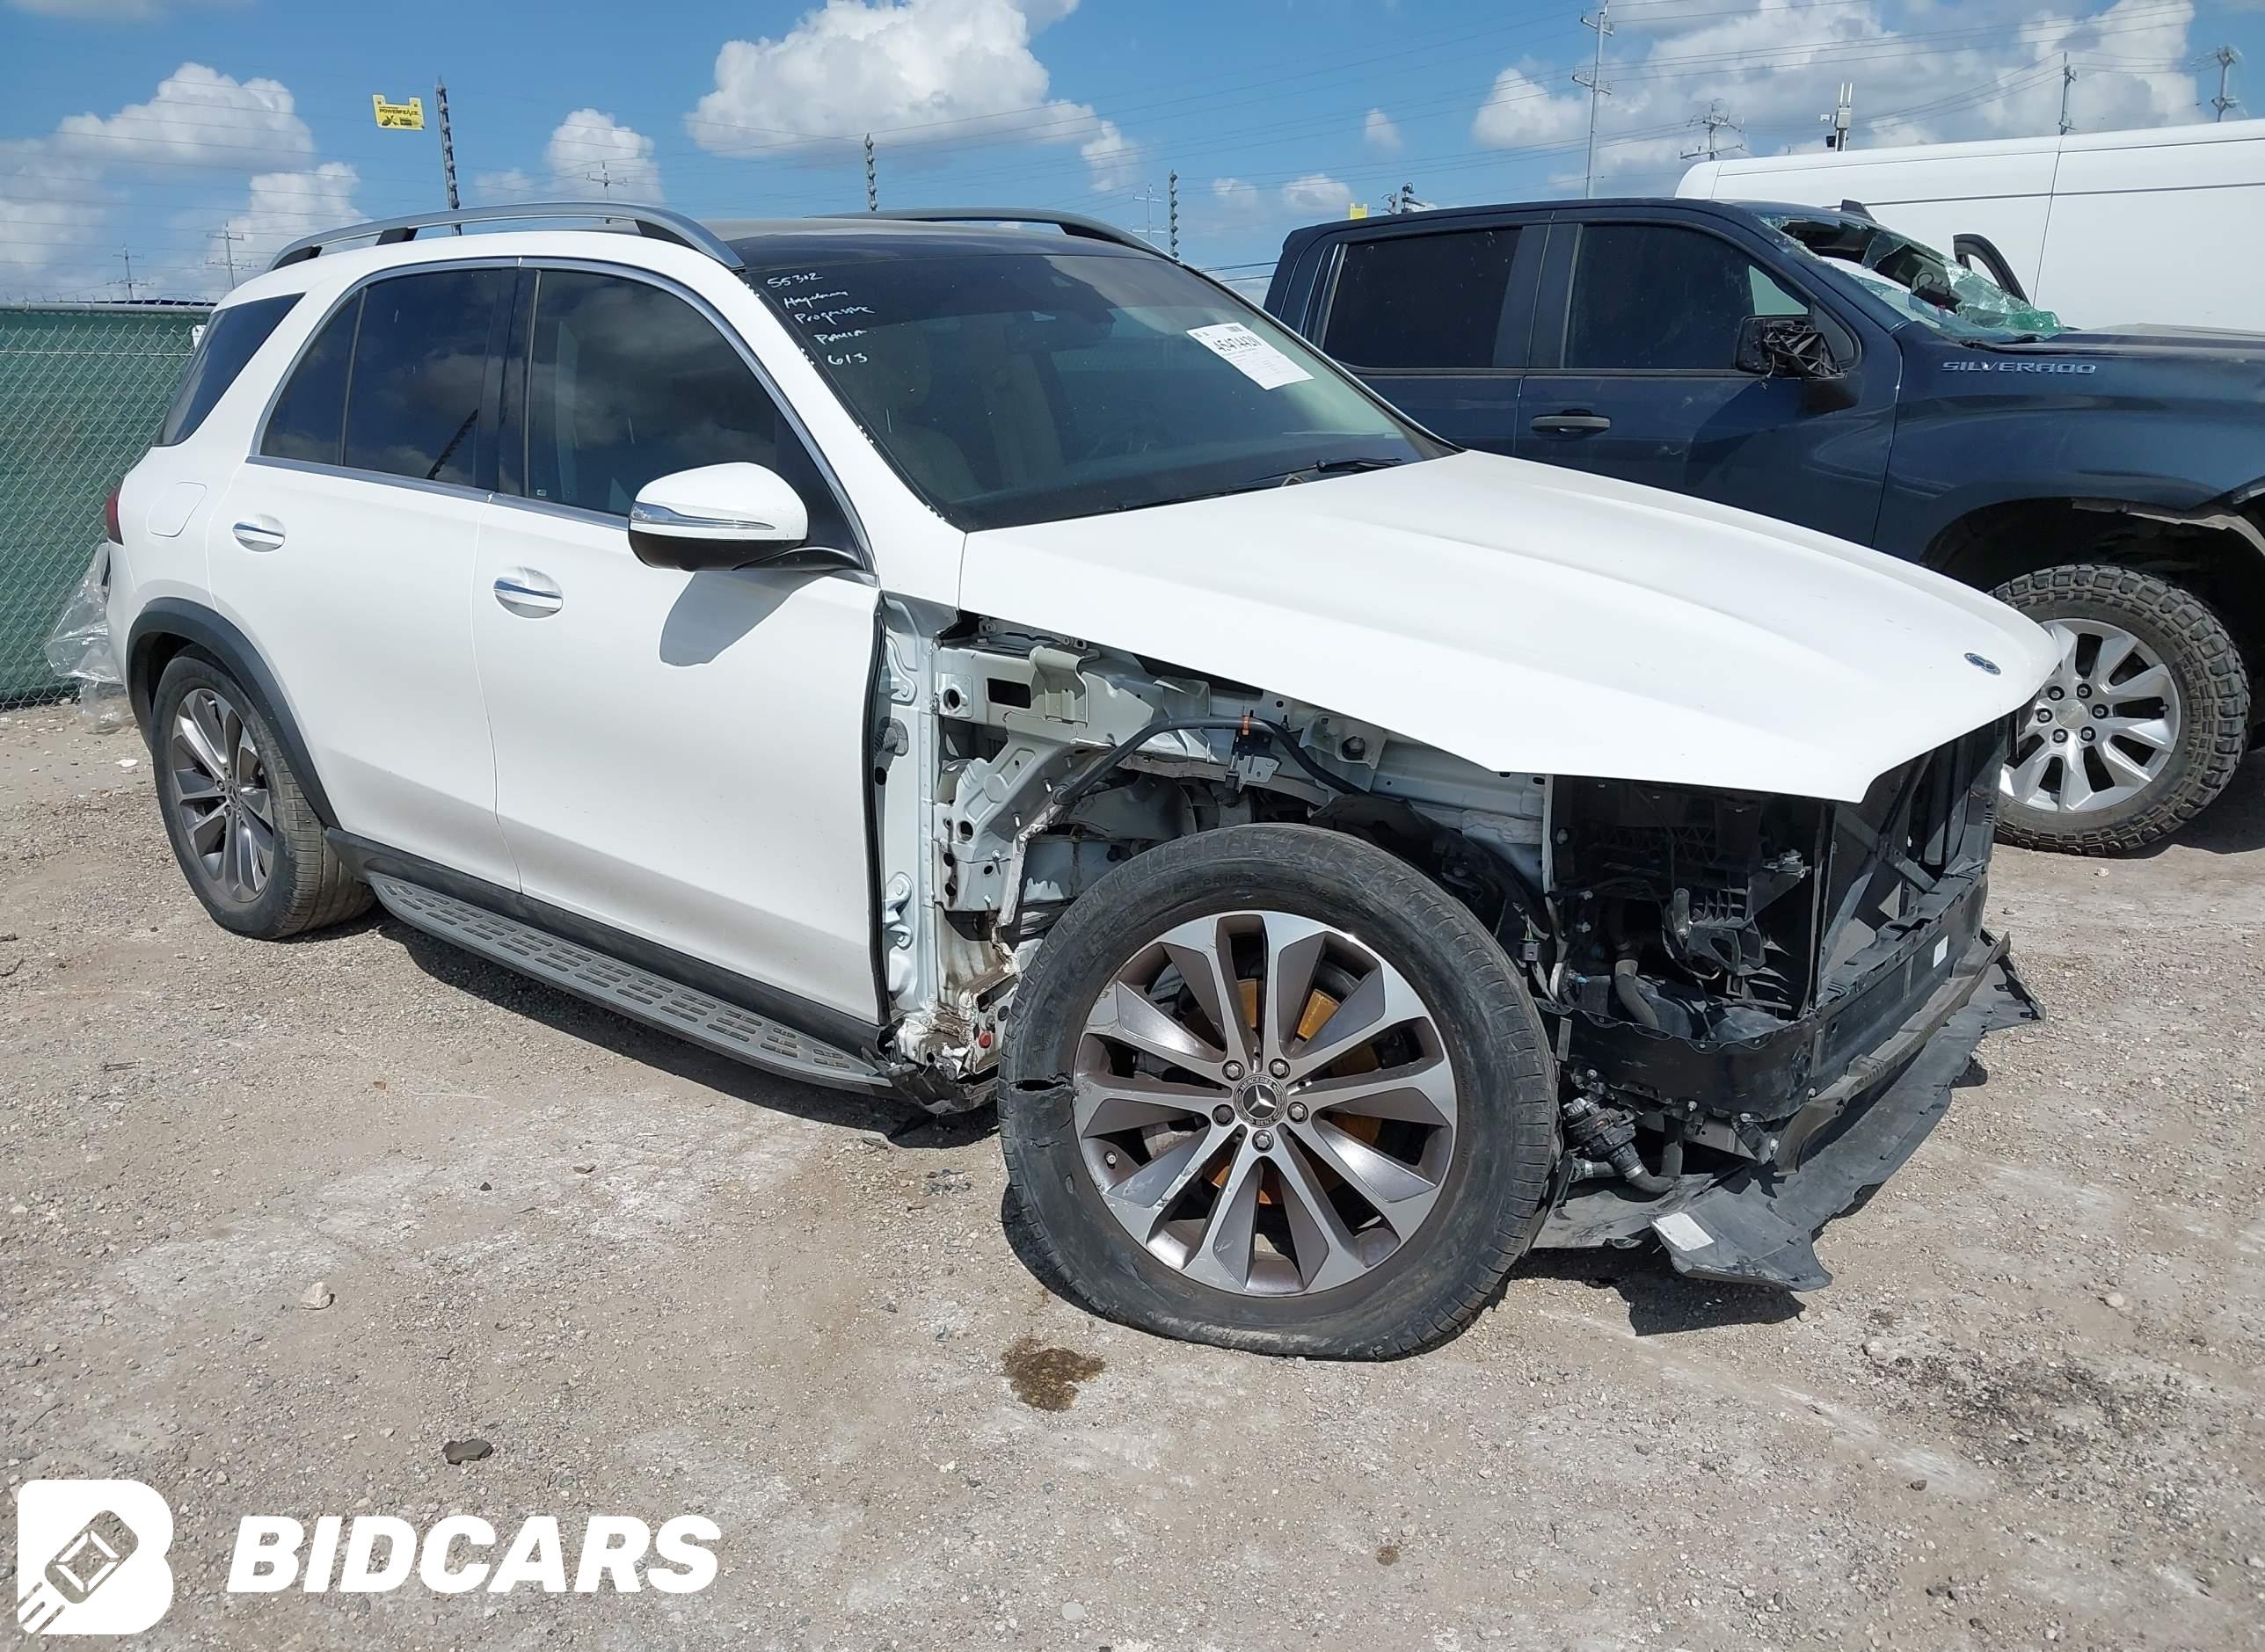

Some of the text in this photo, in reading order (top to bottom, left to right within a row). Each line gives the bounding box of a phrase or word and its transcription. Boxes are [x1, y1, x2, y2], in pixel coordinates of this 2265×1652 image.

[1941, 361, 2097, 375] SILVERADO
[1240, 1076, 1273, 1091] MERCEDES
[1256, 1117, 1274, 1126] BENZ
